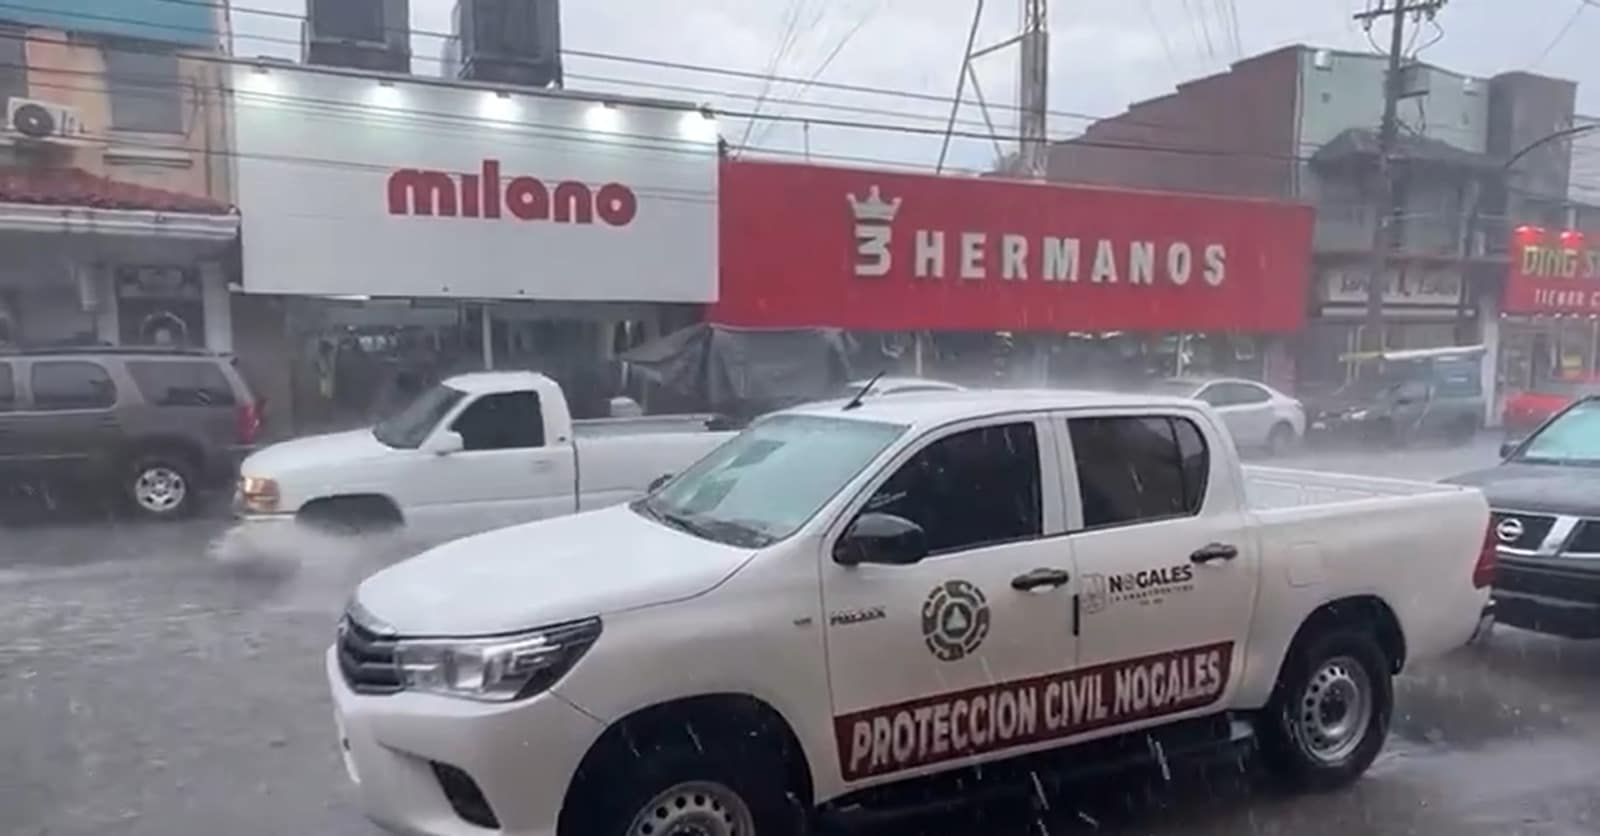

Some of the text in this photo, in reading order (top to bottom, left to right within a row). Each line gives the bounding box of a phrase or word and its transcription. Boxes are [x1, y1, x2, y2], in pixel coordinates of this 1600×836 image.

[388, 160, 637, 226] milano
[855, 224, 1227, 285] 3 HERMANOS
[1109, 564, 1193, 593] NOGALES
[849, 649, 1221, 772] PROTECCION CIVIL NOGALES
